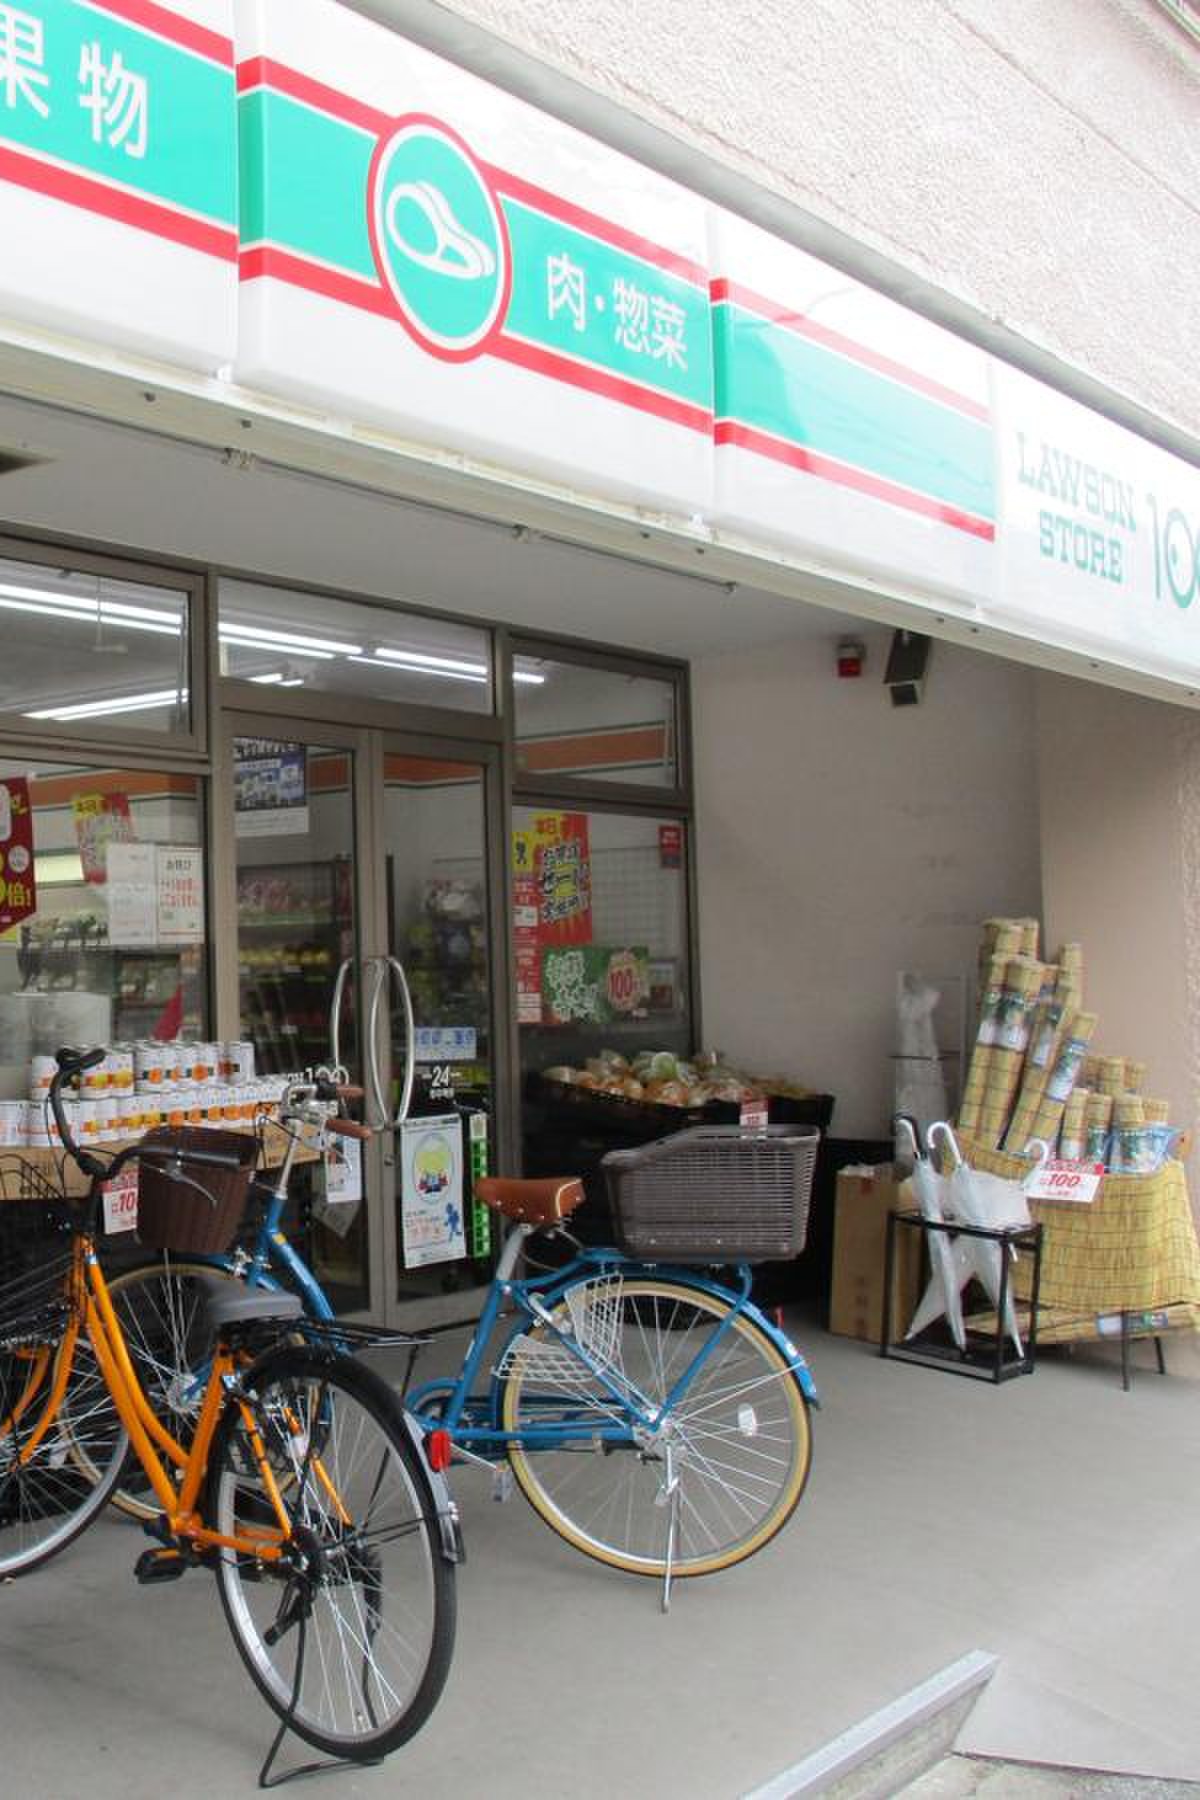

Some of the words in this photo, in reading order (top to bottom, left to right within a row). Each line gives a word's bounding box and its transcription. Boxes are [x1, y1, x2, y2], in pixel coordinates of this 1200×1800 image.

[1017, 431, 1137, 532] LAWSON
[1039, 508, 1123, 584] STORE
[1146, 492, 1200, 608] 10
[431, 1065, 451, 1088] 24
